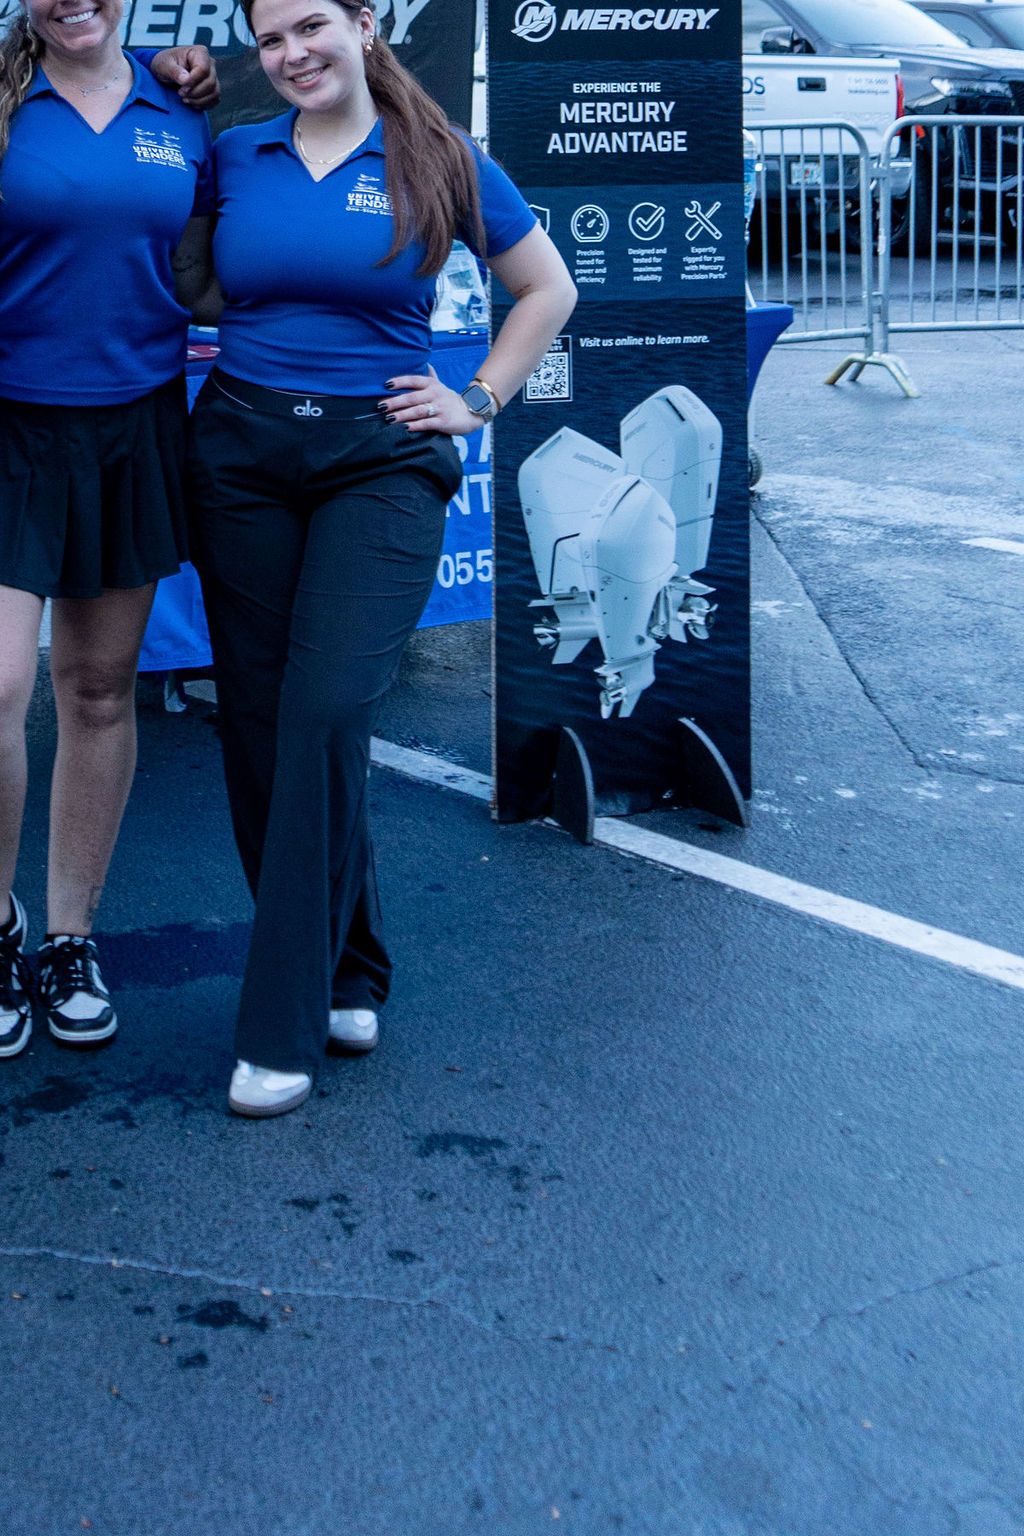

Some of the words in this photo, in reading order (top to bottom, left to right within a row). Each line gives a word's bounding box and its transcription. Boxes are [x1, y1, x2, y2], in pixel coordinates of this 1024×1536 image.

[560, 8, 720, 30] MERCURY
[573, 83, 638, 93] EXPERIENCE
[639, 82, 661, 93] THE
[560, 101, 676, 124] MERCURY
[547, 131, 688, 154] ADVANTAGE
[655, 247, 667, 255] and
[690, 246, 717, 254] Expertly
[653, 256, 662, 264] for
[712, 255, 725, 263] you
[698, 264, 724, 272] Mercury
[576, 275, 606, 284] efficiency
[633, 274, 663, 282] reliability
[681, 272, 708, 280] Precision
[580, 337, 601, 347] Visit
[602, 338, 614, 346] us
[614, 336, 644, 346] online
[645, 337, 656, 345] to
[657, 335, 682, 345] learn
[683, 336, 710, 344] more.
[293, 399, 323, 417] alo
